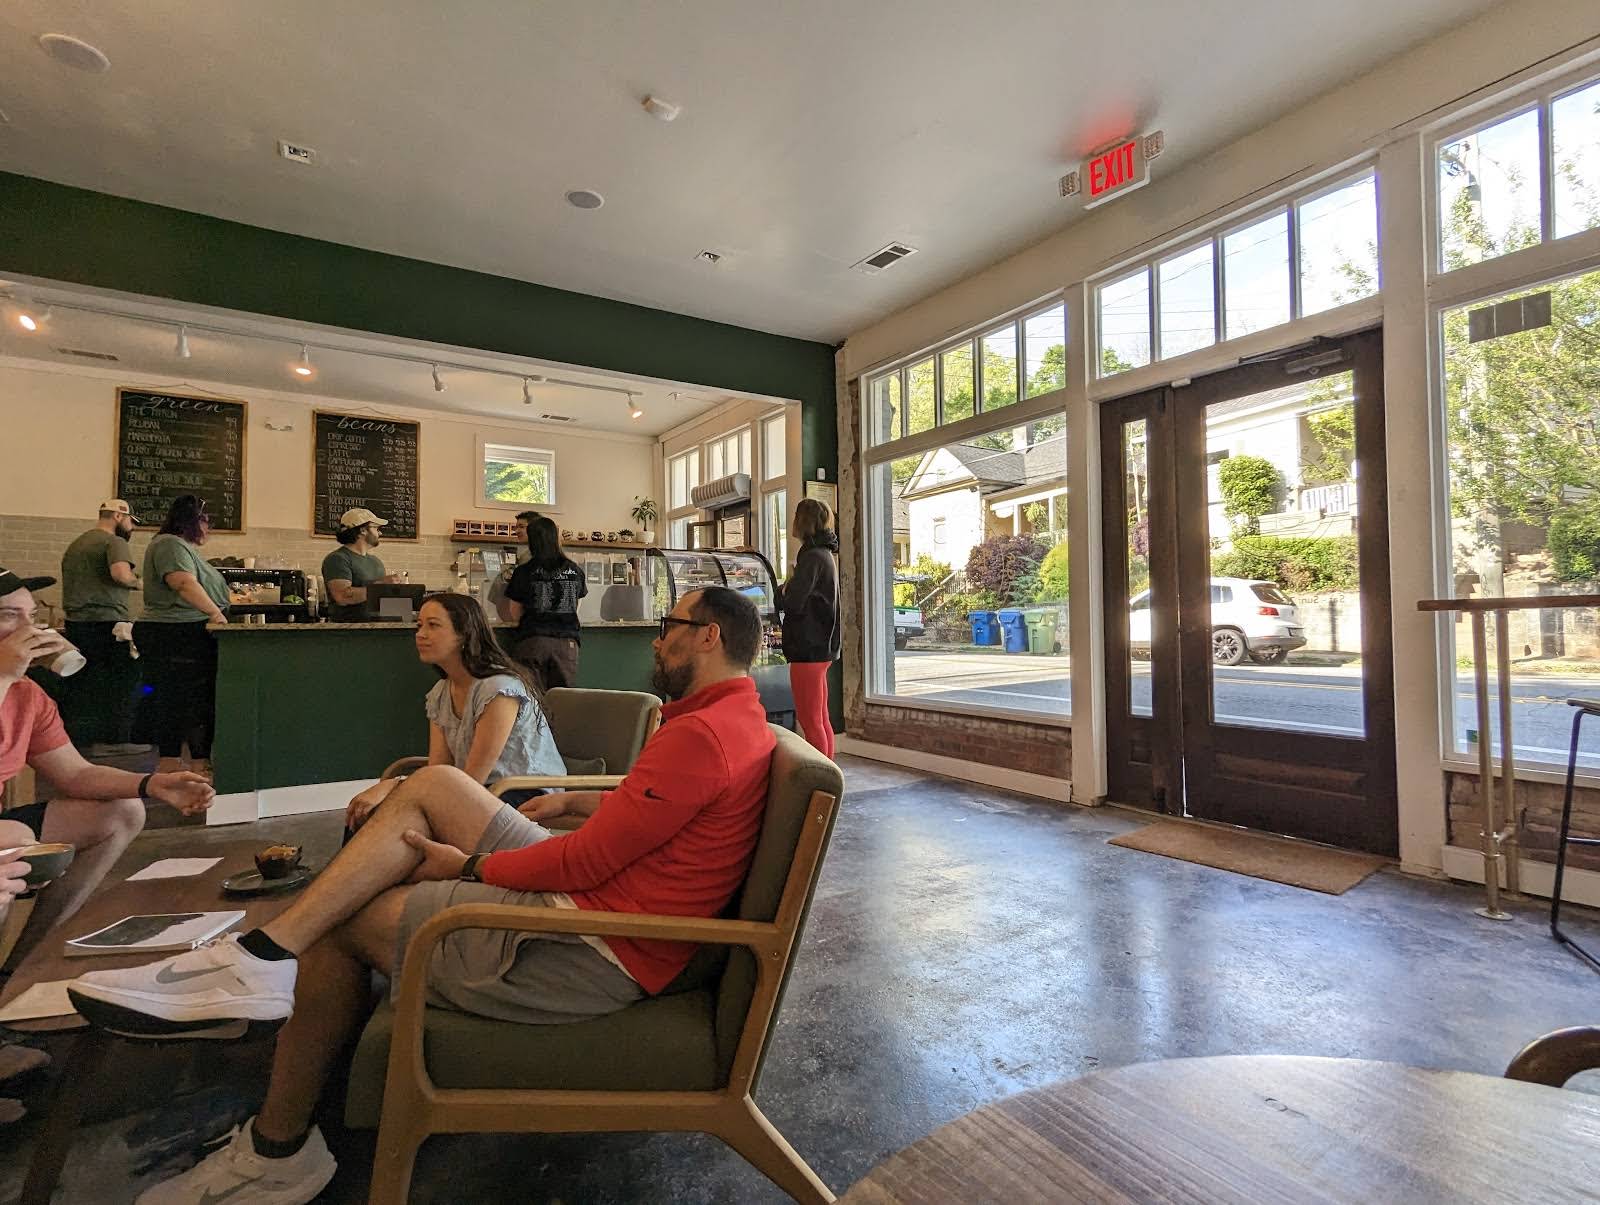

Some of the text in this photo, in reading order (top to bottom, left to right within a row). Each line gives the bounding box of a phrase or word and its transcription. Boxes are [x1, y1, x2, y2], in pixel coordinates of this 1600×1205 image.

[1089, 142, 1136, 196] EXIT
[147, 396, 224, 413] green
[337, 416, 396, 433] beans
[328, 449, 351, 458] LATTE
[345, 466, 361, 474] OVER
